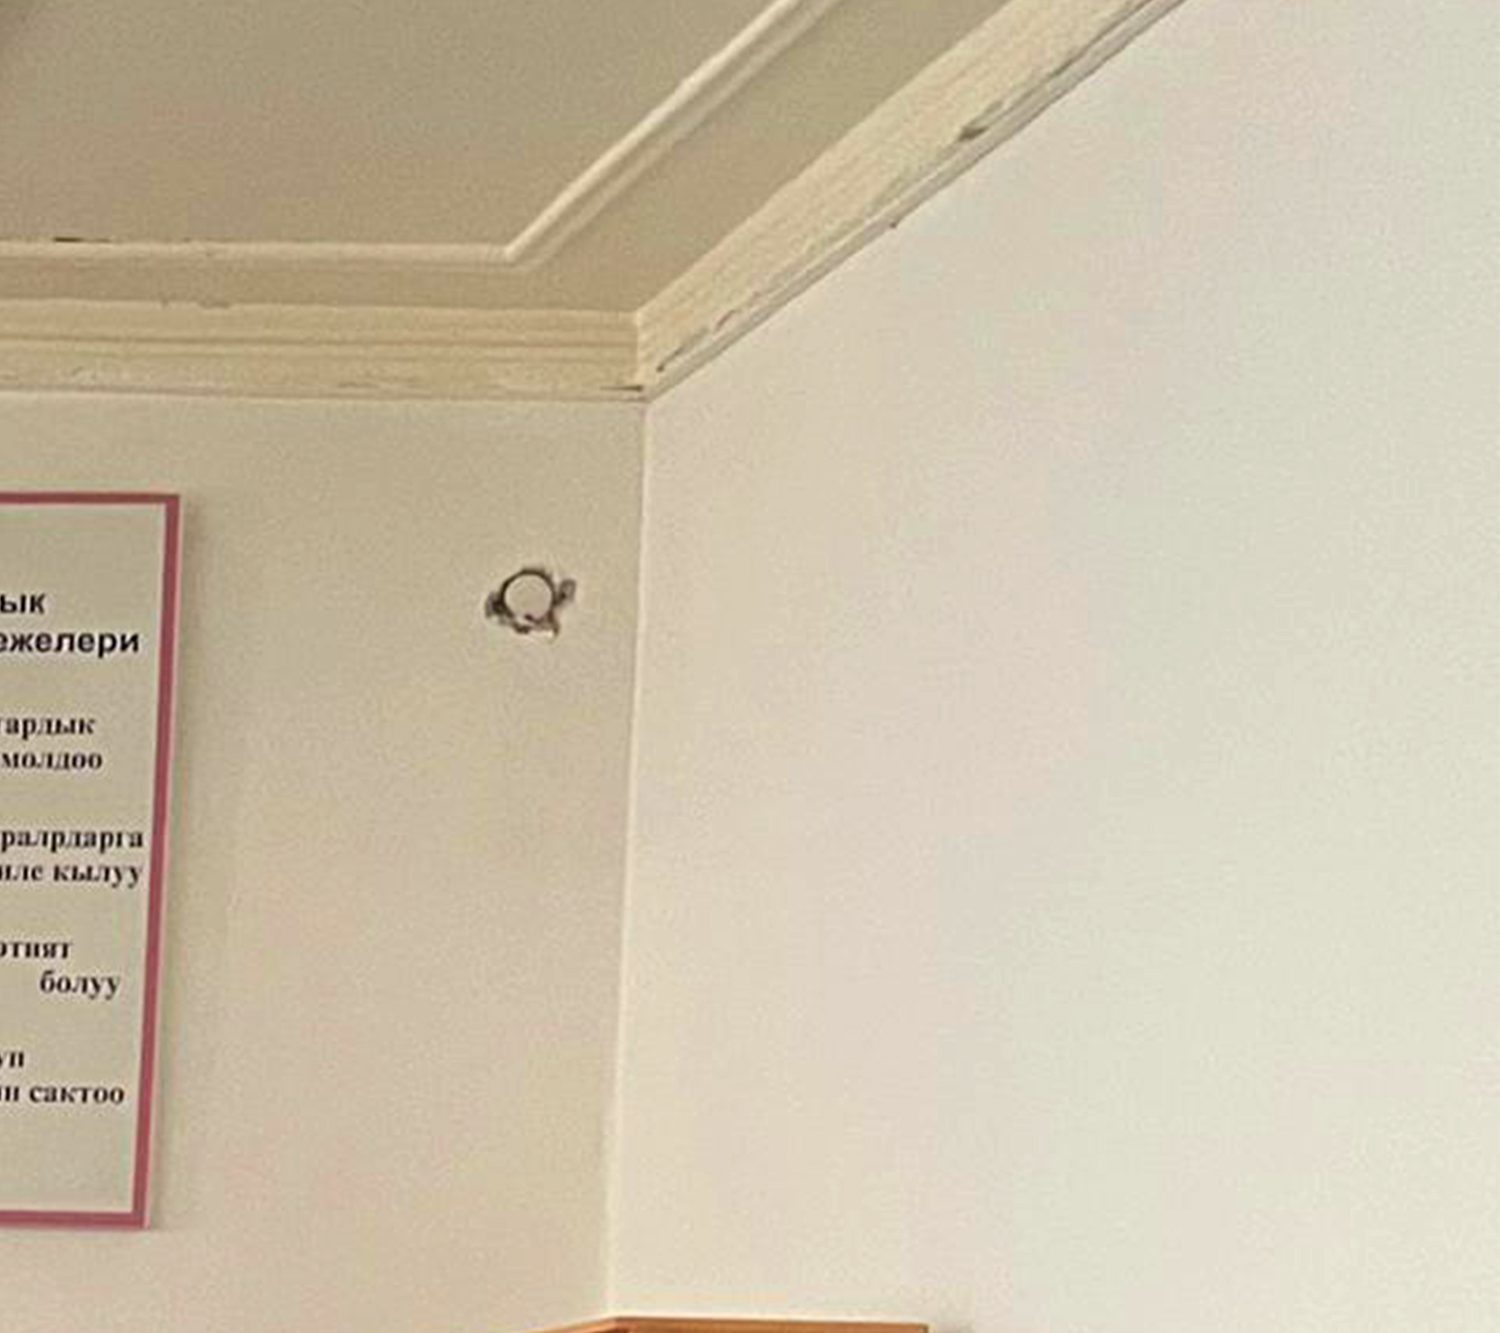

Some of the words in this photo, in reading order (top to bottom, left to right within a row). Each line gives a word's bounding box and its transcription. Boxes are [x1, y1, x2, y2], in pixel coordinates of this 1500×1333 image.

[53, 863, 144, 888] кылуу
[39, 969, 123, 999] болуу
[28, 1084, 126, 1105] сактоо
